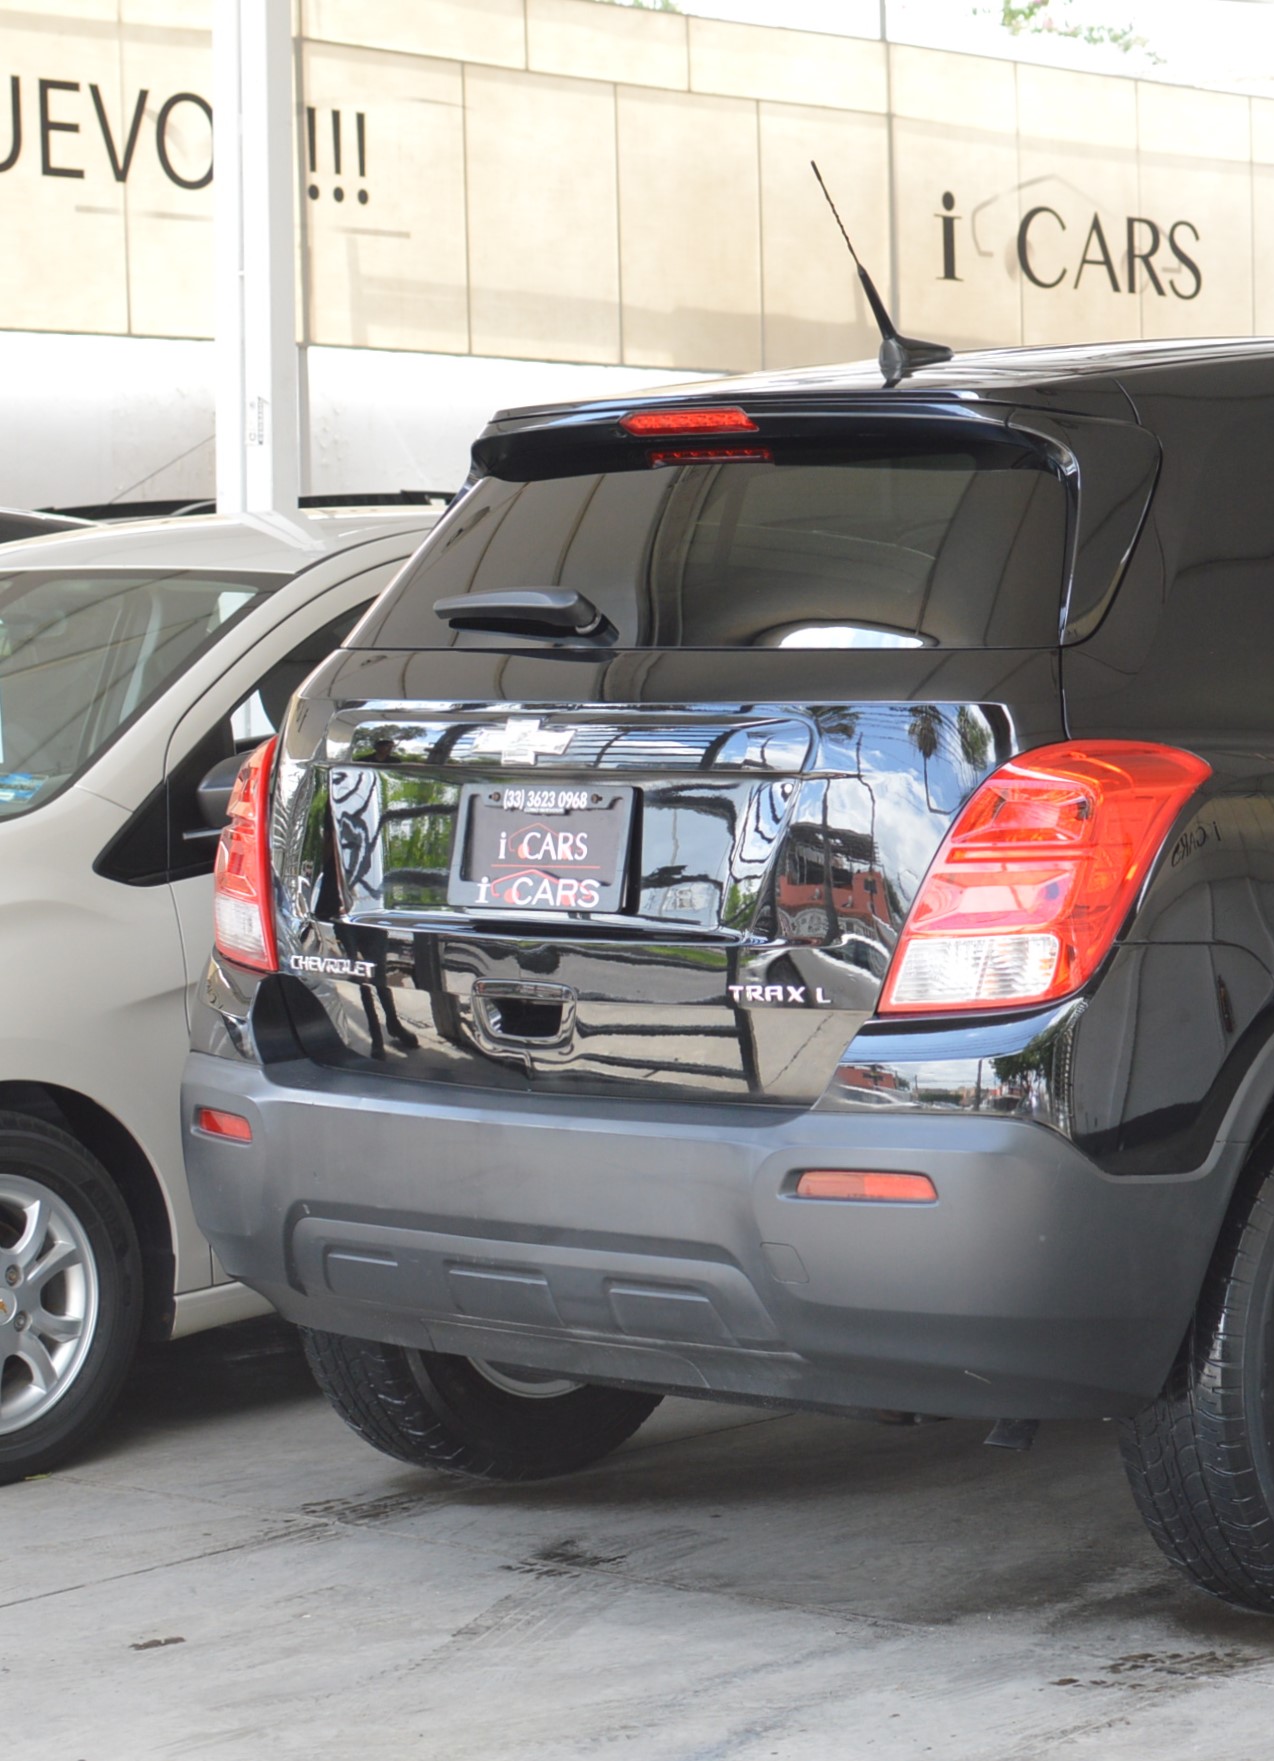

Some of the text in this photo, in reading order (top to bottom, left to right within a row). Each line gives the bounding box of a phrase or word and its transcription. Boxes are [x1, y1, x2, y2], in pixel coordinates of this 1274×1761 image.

[934, 191, 1202, 300] i CARS
[503, 788, 588, 810] (33) 3623 0968
[498, 831, 588, 860] i CARS
[475, 876, 600, 909] i CARS
[290, 954, 377, 978] CHEVROLET
[728, 985, 832, 1004] TRAX L
